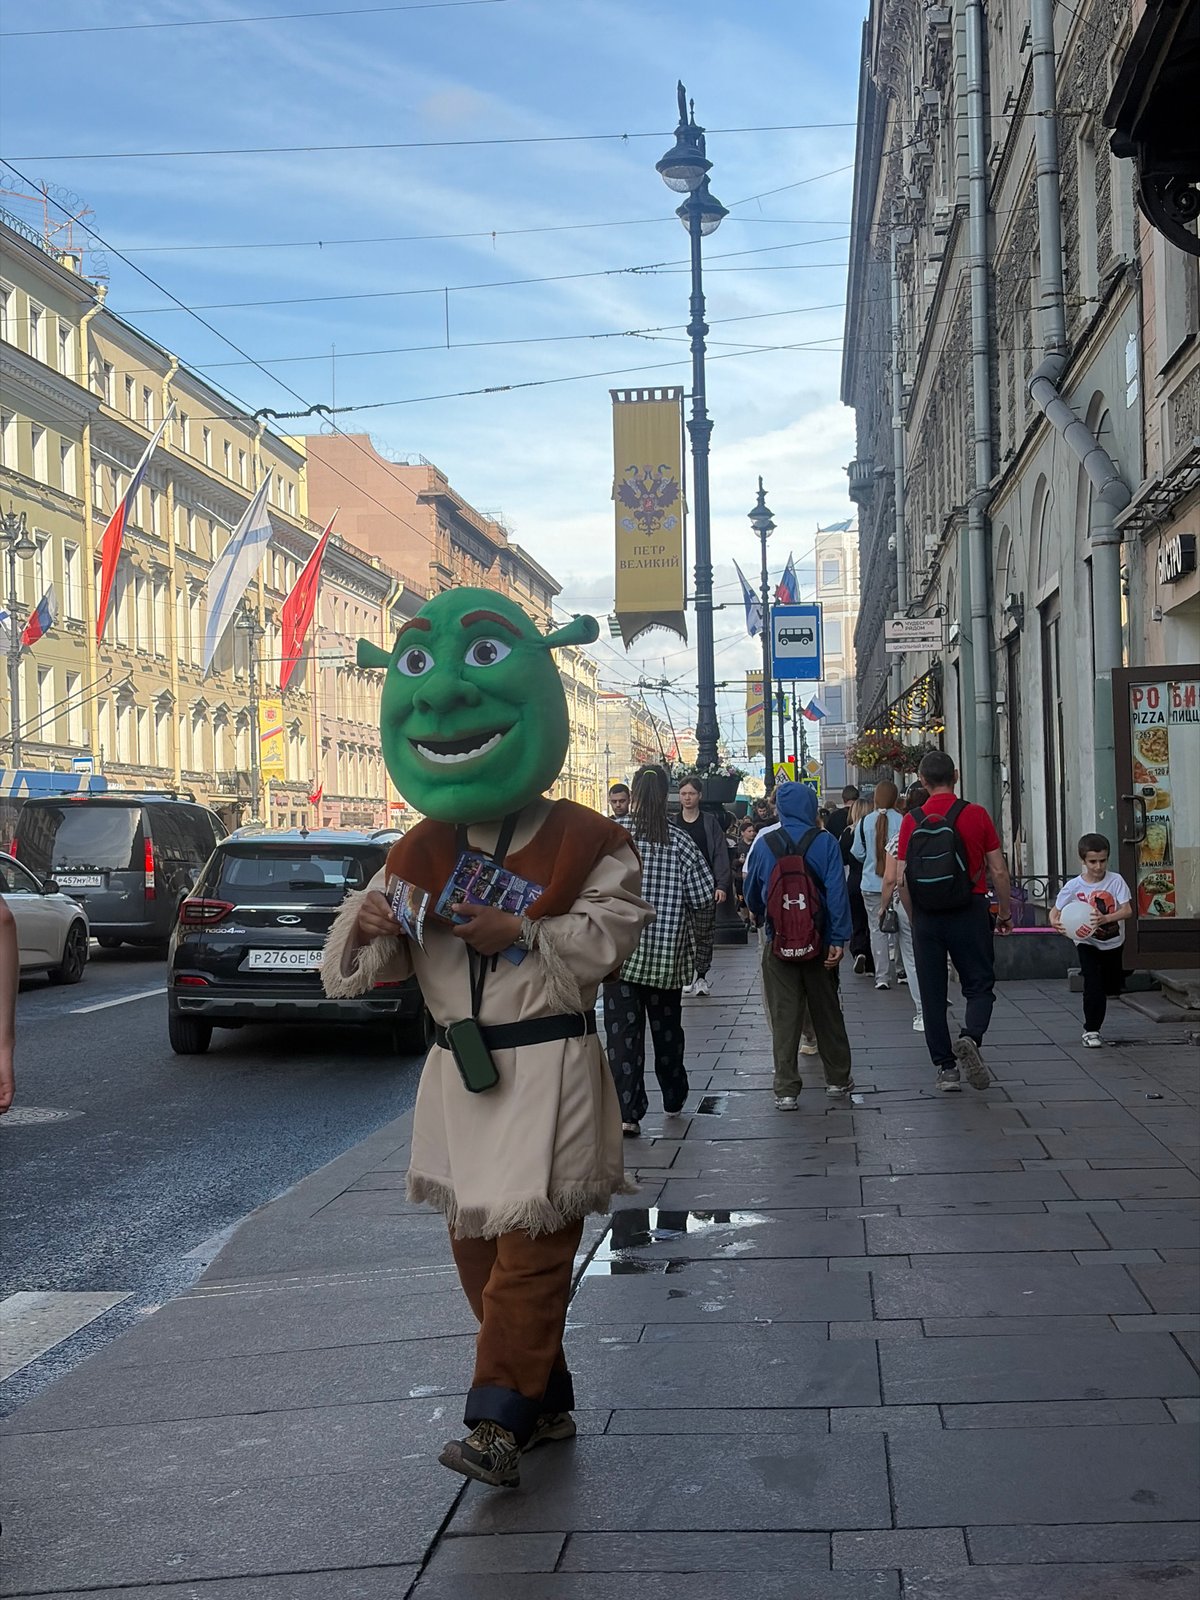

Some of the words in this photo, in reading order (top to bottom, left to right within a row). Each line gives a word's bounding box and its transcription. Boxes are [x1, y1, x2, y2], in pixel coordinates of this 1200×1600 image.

[633, 545, 666, 555] ПЕТР
[620, 555, 679, 569] ВЕЛИКИЙ
[1132, 711, 1165, 725] PIZZA
[1136, 815, 1170, 823] ШВЕРМА
